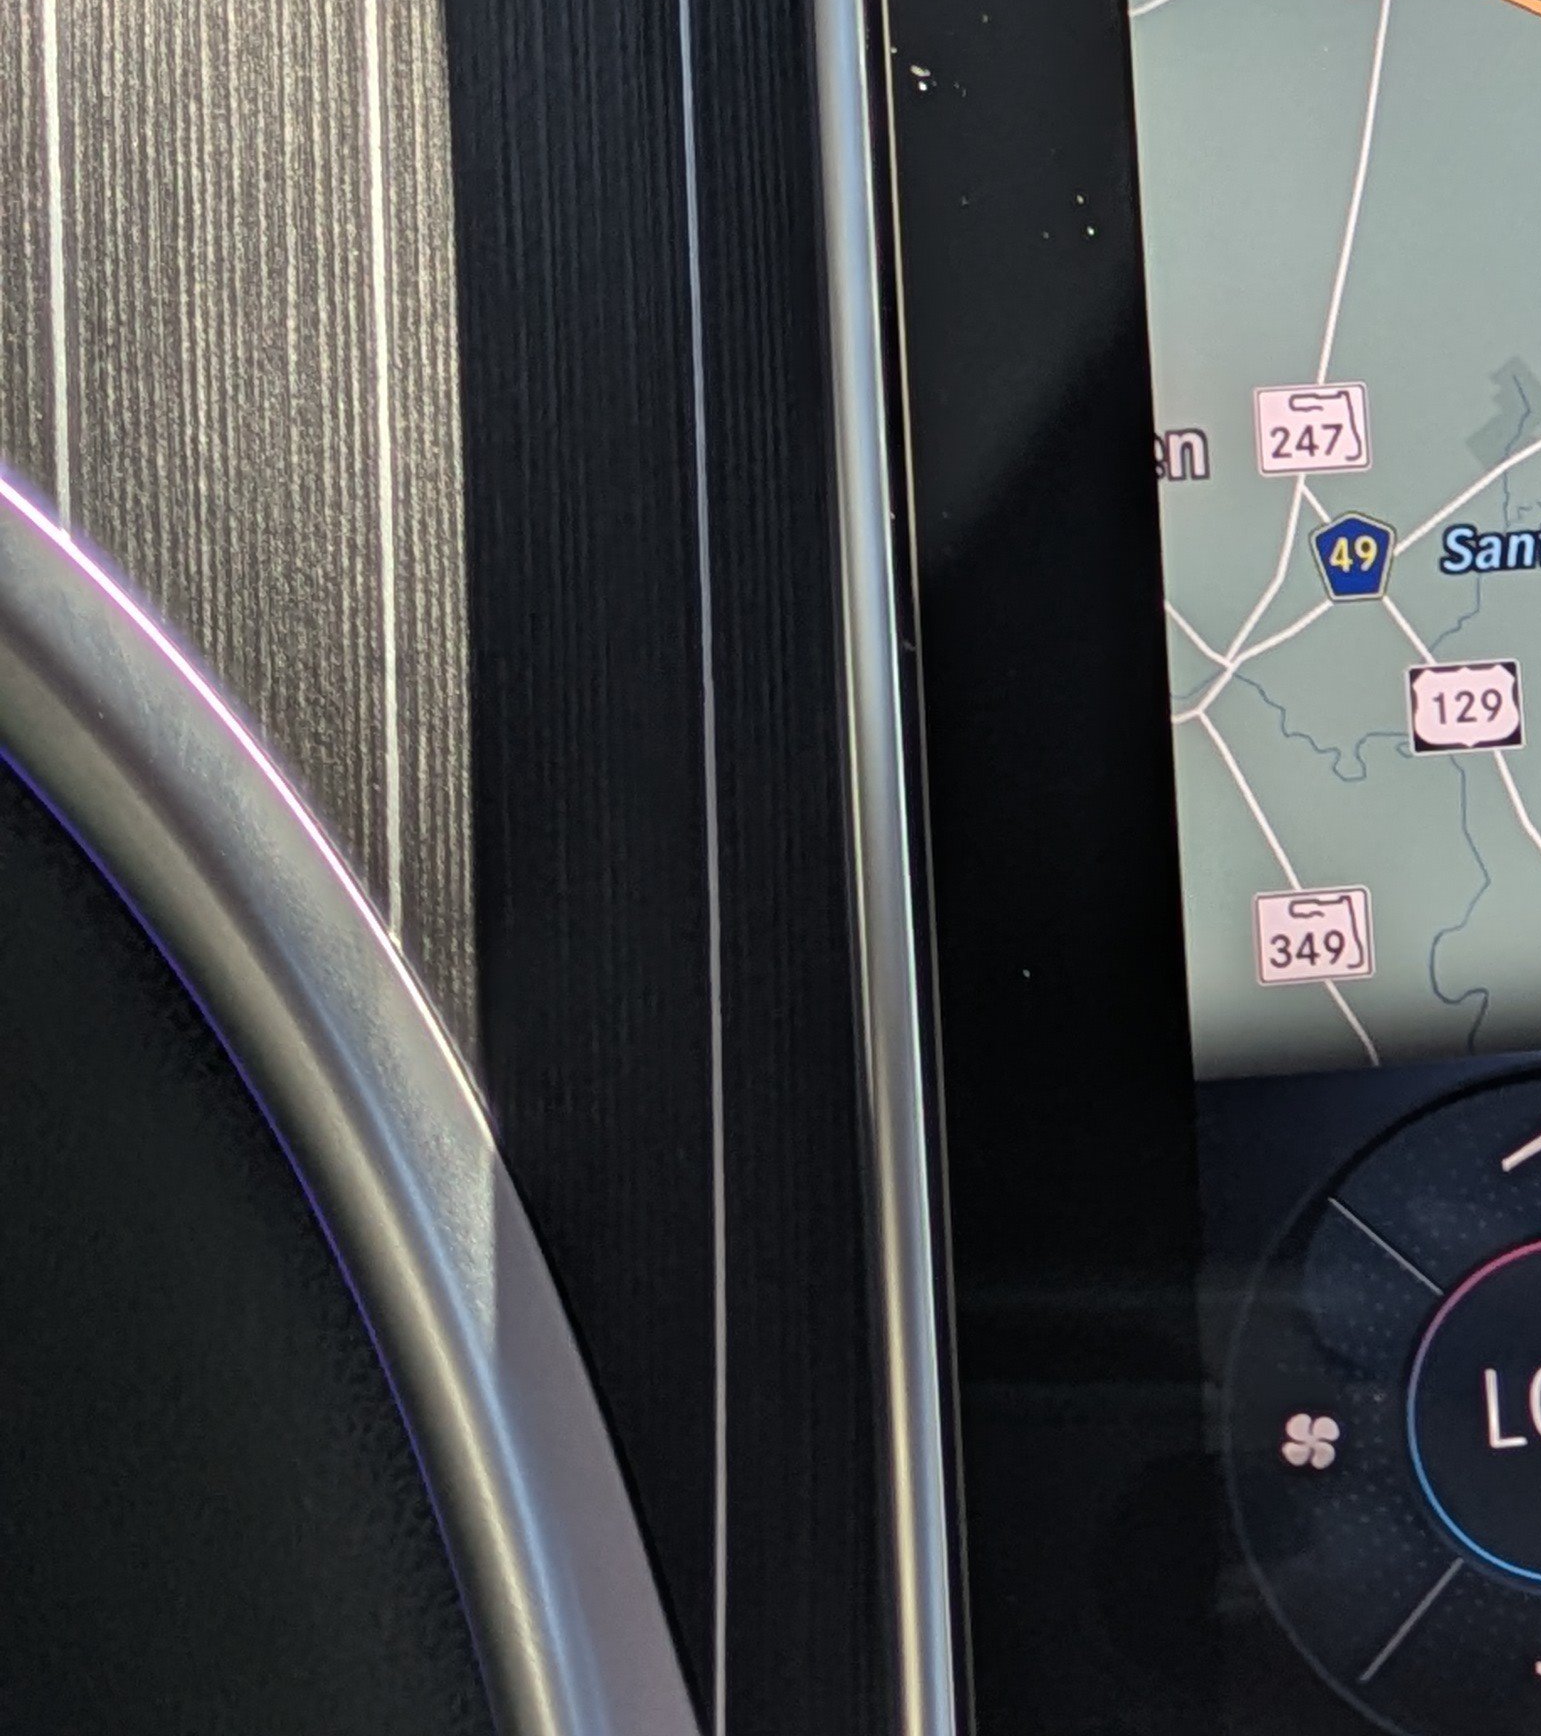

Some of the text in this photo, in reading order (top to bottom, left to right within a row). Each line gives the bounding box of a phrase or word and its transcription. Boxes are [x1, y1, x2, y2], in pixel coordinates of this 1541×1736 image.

[1269, 422, 1344, 460] 247
[1328, 534, 1379, 574] 49
[1430, 688, 1503, 728] 129
[1267, 927, 1347, 971] 349
